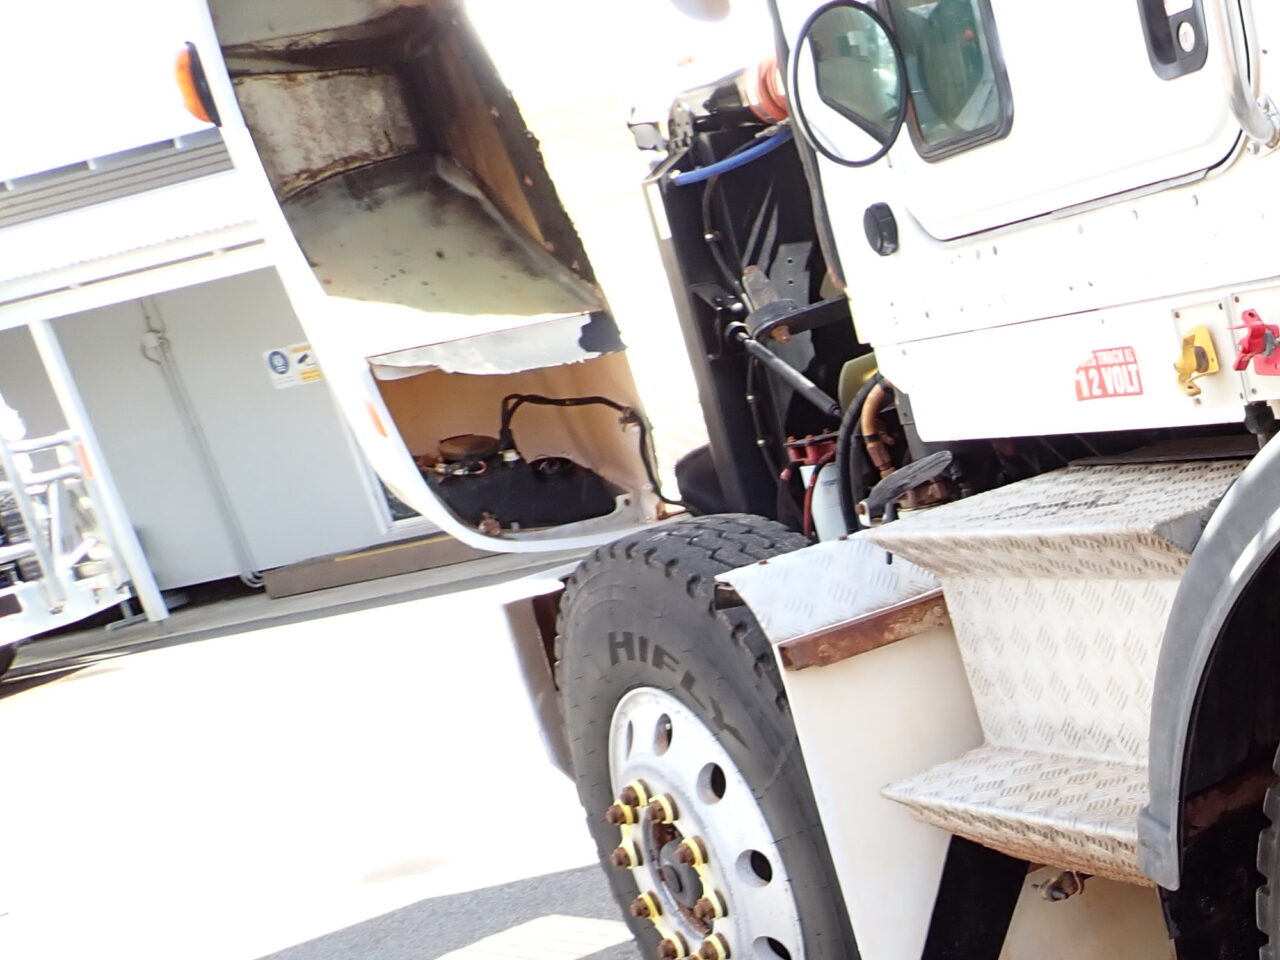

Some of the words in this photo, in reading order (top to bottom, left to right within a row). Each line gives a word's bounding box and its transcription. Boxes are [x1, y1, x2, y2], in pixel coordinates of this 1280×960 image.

[1077, 367, 1103, 398] 12
[1100, 363, 1142, 395] VOLT
[608, 631, 750, 751] HIFLY
